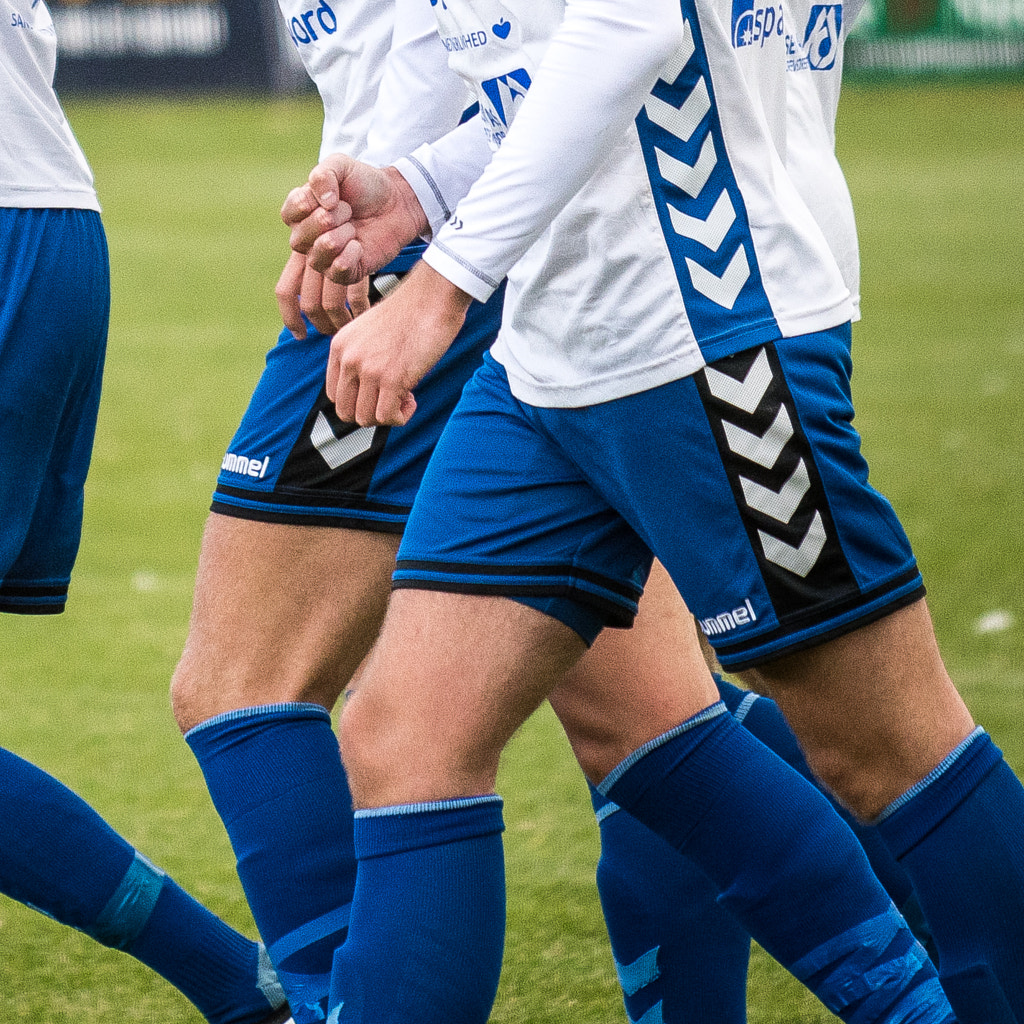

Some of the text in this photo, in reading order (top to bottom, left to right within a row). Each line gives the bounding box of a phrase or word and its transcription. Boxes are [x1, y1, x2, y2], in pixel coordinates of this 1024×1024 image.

[288, 0, 337, 47] ord
[753, 4, 784, 49] spa
[697, 598, 757, 636] ummel
